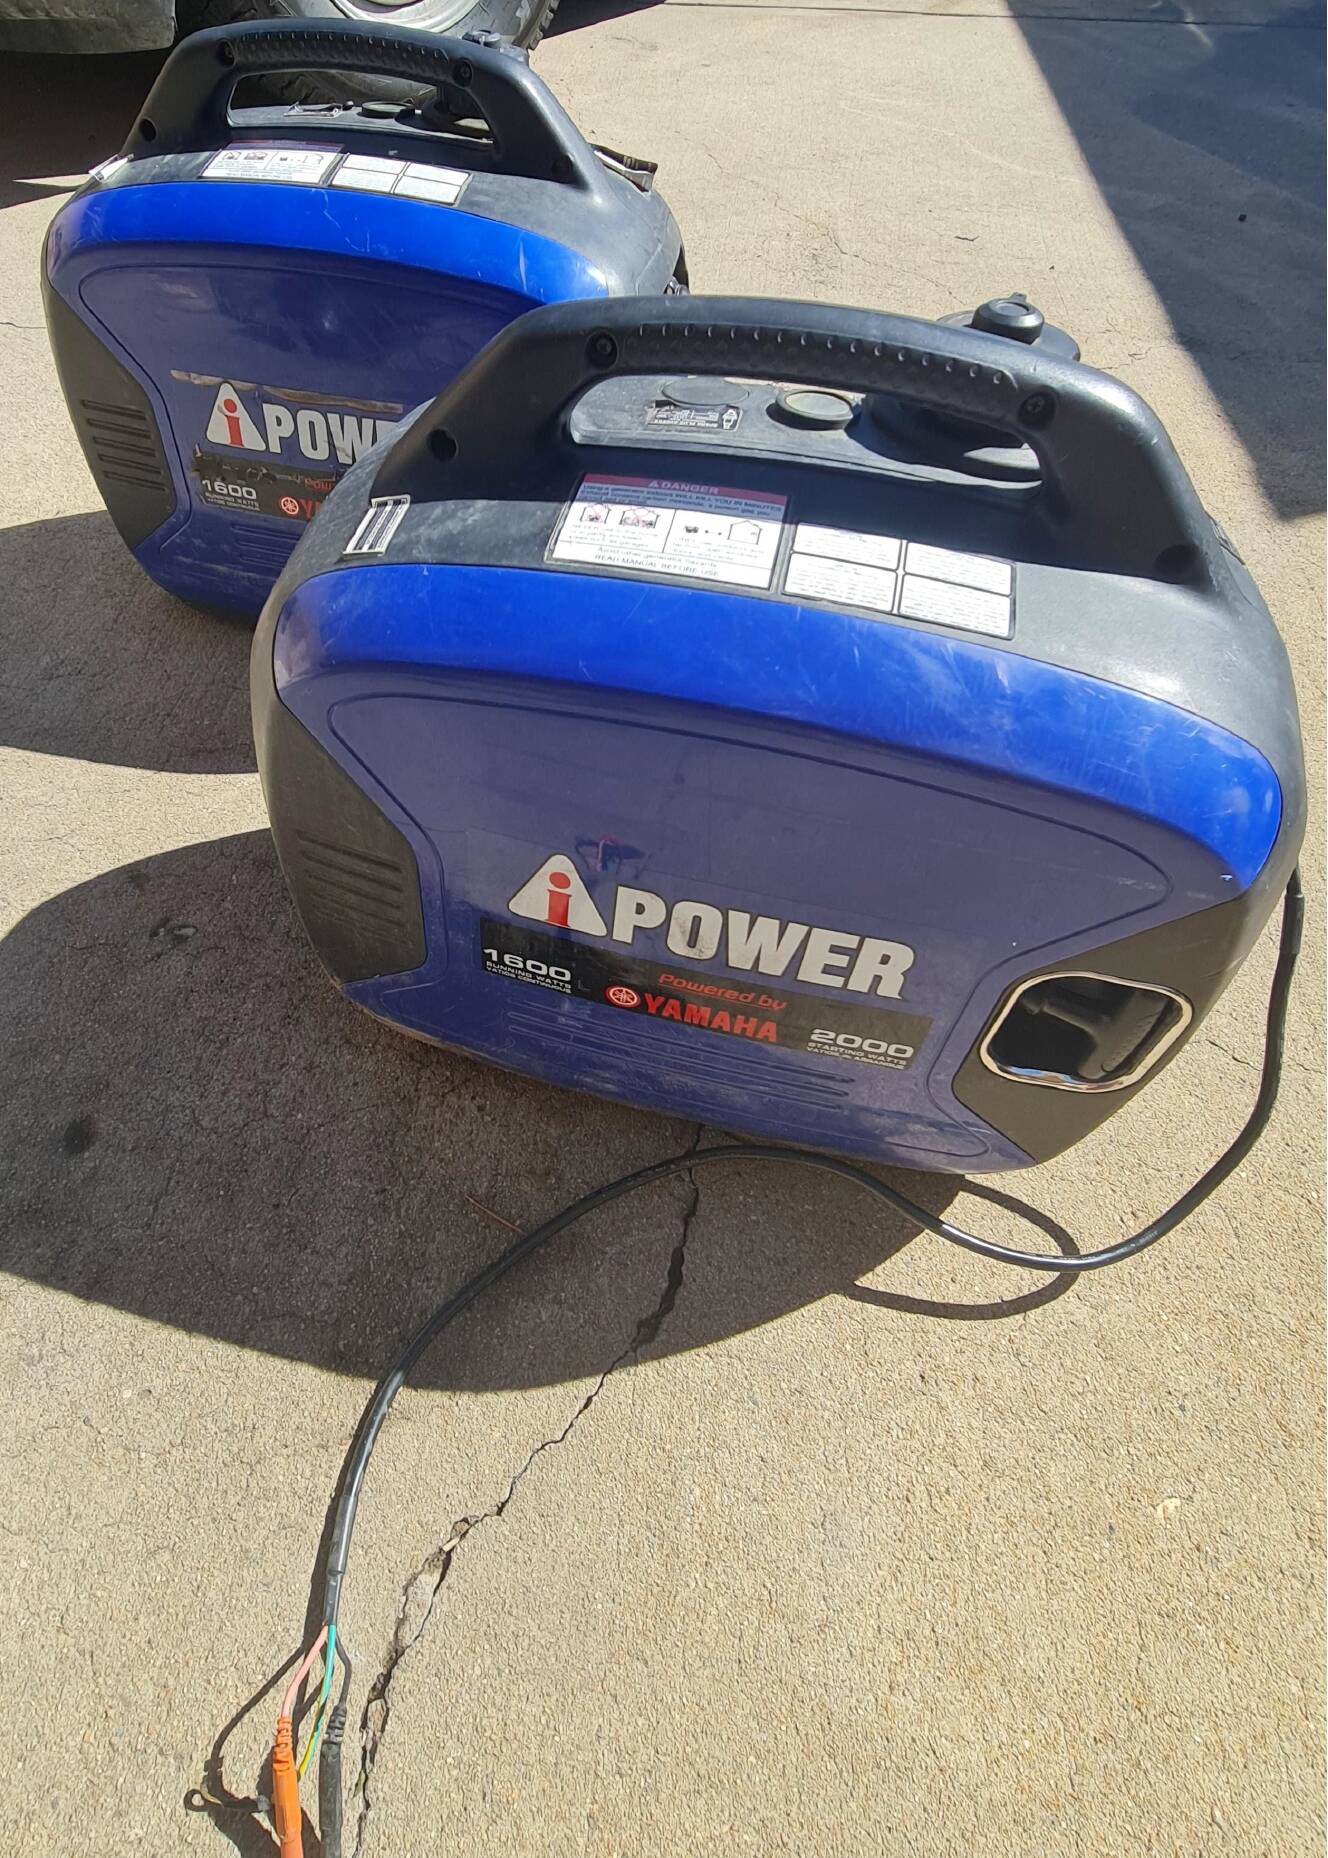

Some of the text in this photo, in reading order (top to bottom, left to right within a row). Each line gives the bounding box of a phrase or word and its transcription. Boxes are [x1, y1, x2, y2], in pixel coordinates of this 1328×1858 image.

[202, 479, 257, 499] 1600
[662, 480, 720, 494] DANGER
[622, 558, 657, 569] MANUAL
[612, 884, 917, 1001] POWER
[483, 948, 572, 982] 1600
[486, 961, 572, 990] RUNNING WATTS
[657, 972, 789, 1012] Powered by
[644, 991, 779, 1044] YAMAHA
[807, 1042, 907, 1066] STARTING WATTS
[809, 1028, 915, 1059] 2000
